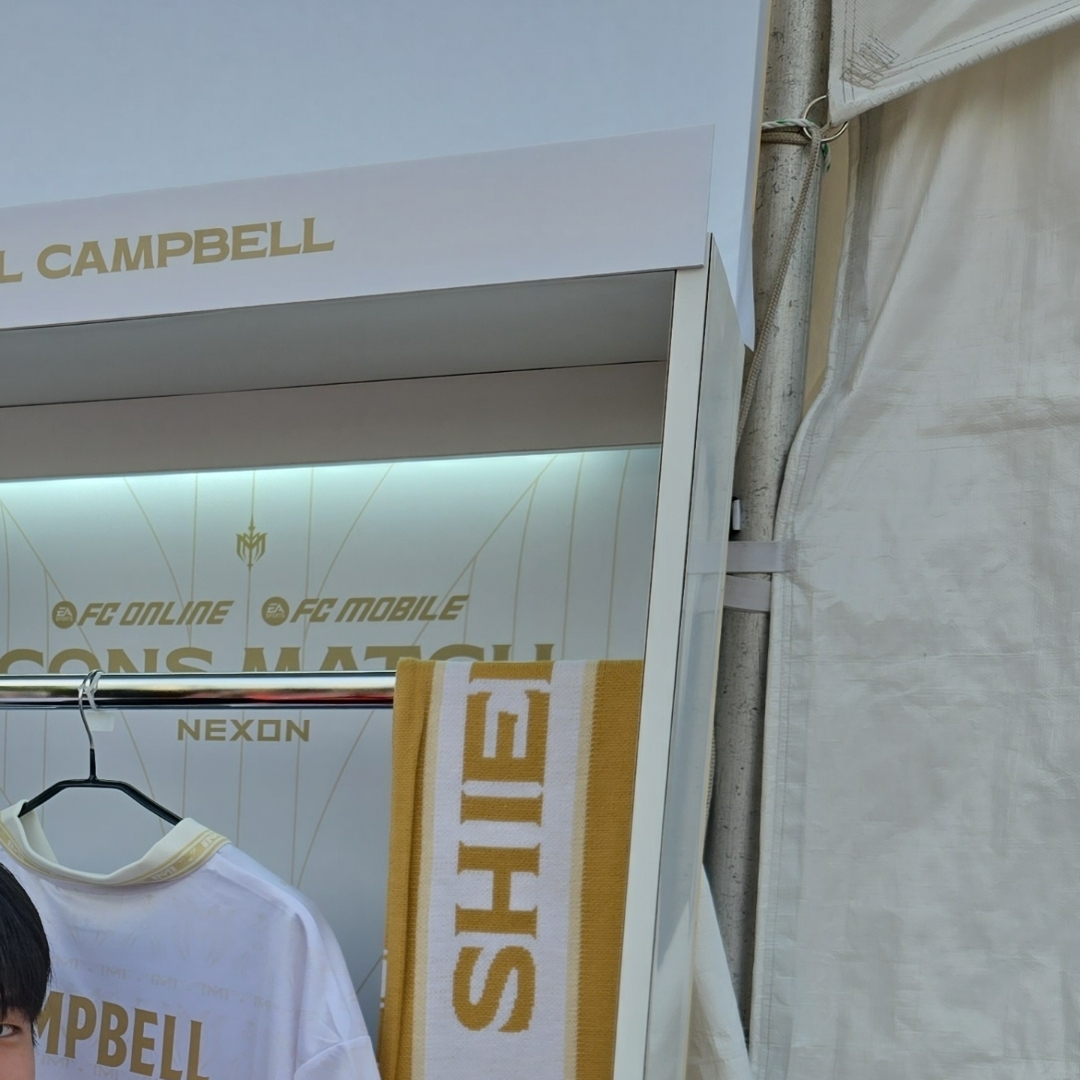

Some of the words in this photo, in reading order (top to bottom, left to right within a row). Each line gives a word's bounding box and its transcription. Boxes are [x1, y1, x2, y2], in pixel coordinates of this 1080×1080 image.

[36, 217, 335, 280] CAMPBELL
[77, 602, 121, 626] FC
[119, 600, 235, 626] ONLINE
[290, 597, 339, 623] FC
[334, 594, 469, 623] MOBILE
[177, 719, 311, 742] NEXON
